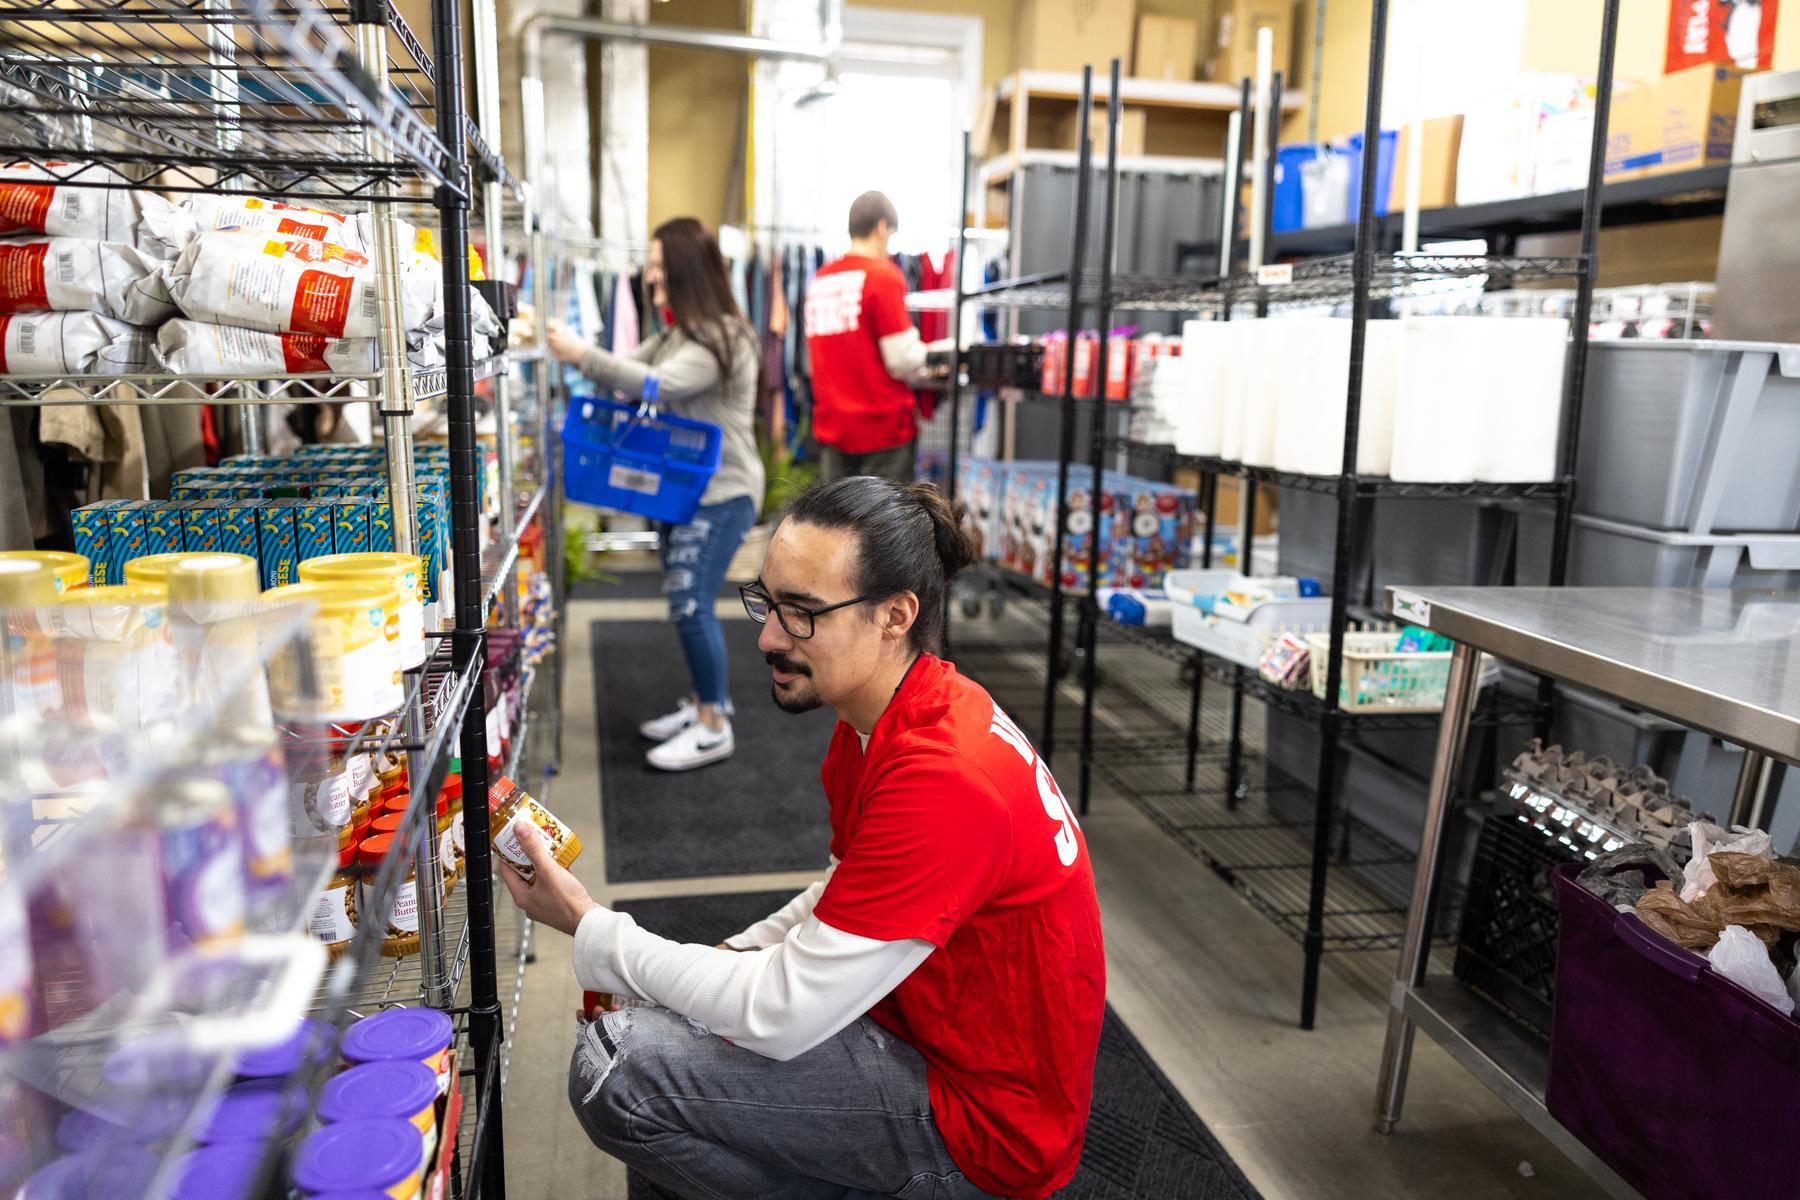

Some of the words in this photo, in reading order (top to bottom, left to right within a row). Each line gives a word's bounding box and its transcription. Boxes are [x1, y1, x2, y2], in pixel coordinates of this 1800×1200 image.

[94, 562, 107, 587] EESE
[278, 559, 291, 587] EESE
[394, 907, 418, 917] Butte
